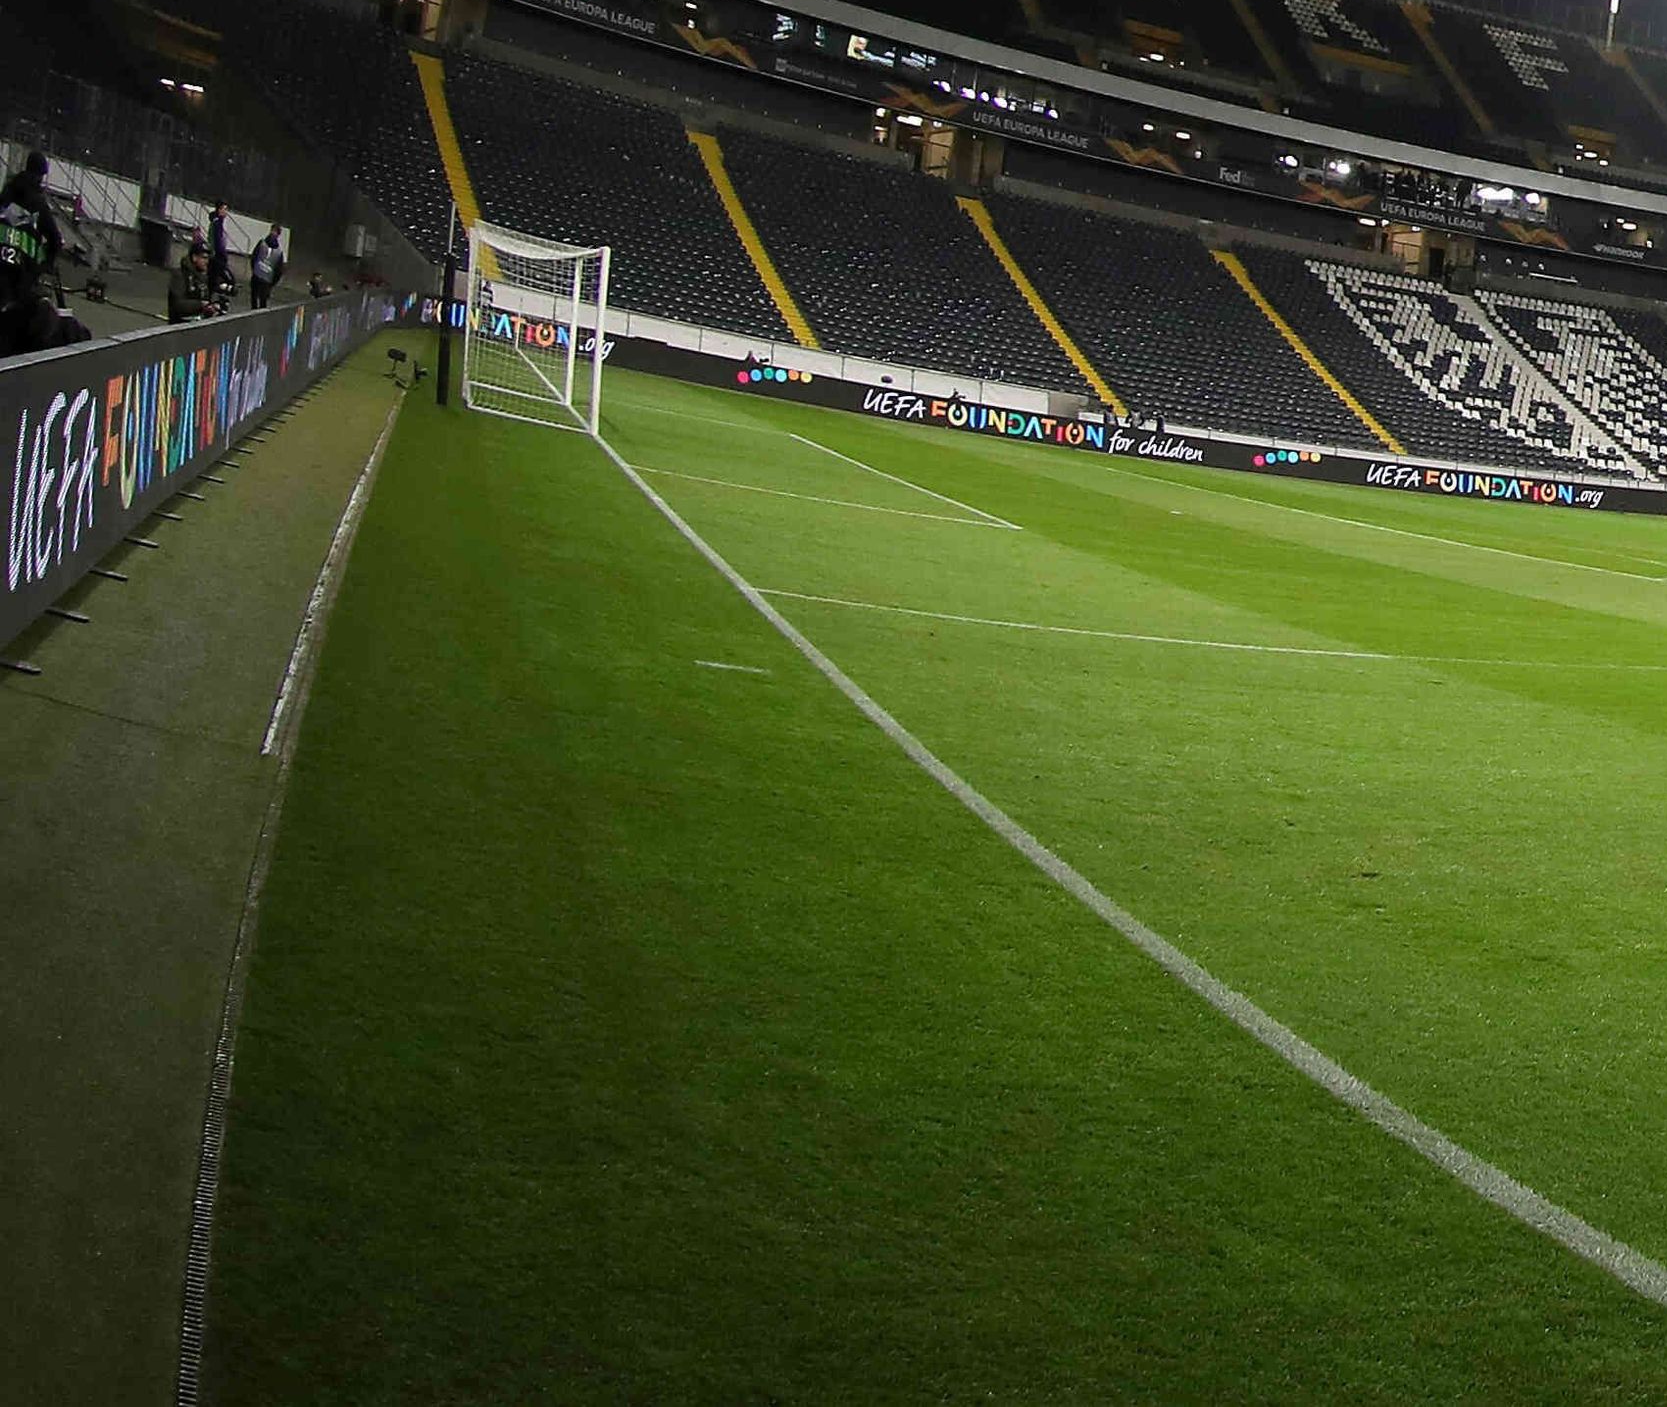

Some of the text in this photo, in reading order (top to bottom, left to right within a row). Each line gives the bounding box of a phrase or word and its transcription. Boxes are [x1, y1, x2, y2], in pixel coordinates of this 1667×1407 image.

[610, 9, 656, 34] LEAGUE
[973, 111, 1088, 149] UEFA EUROPA LEAGUE
[1380, 200, 1486, 232] UEFA EUROPA LEAGUE
[864, 388, 1204, 462] UEFA FOUNDATION for children
[8, 388, 99, 592] UEFA
[102, 341, 231, 510] FOUNDATION
[1366, 463, 1421, 487] UEFA
